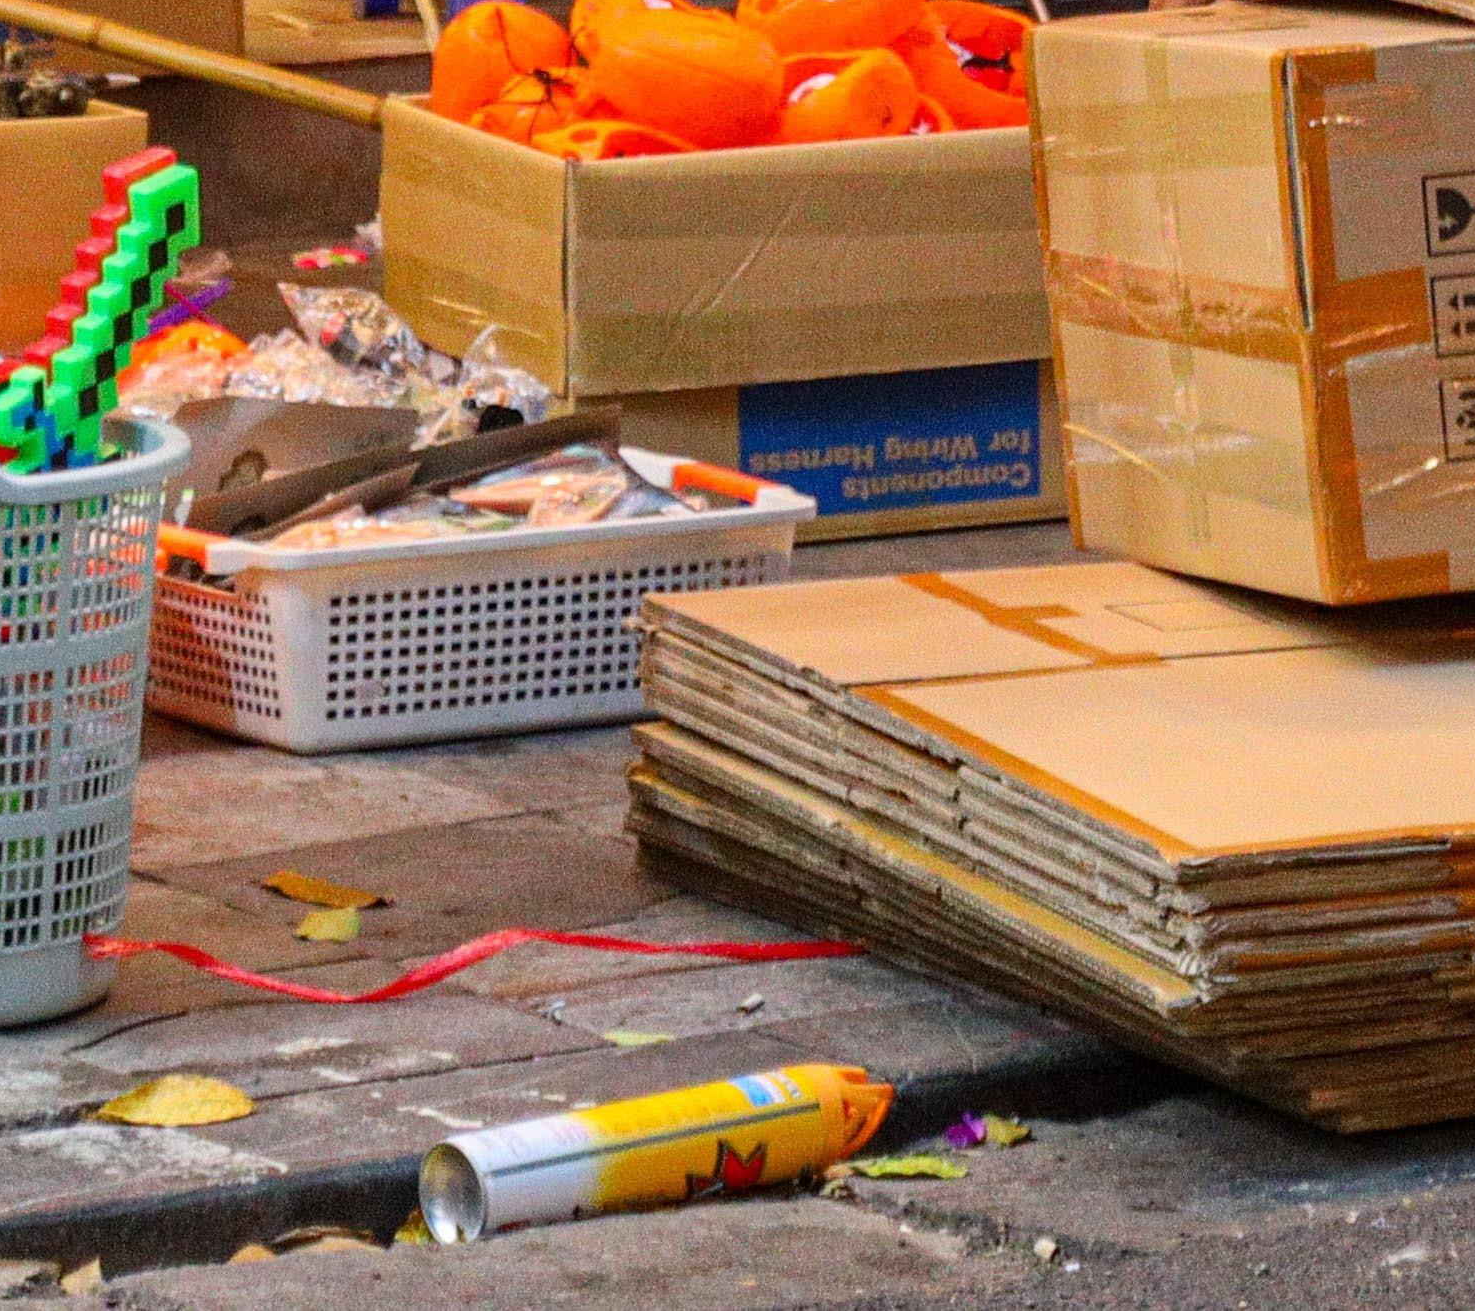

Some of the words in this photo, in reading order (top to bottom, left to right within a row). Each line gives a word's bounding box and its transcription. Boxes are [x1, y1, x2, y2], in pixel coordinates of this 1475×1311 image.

[884, 435, 978, 461] Wiring
[991, 431, 1031, 454] for
[748, 444, 876, 474] Harness
[842, 461, 1031, 499] Components
